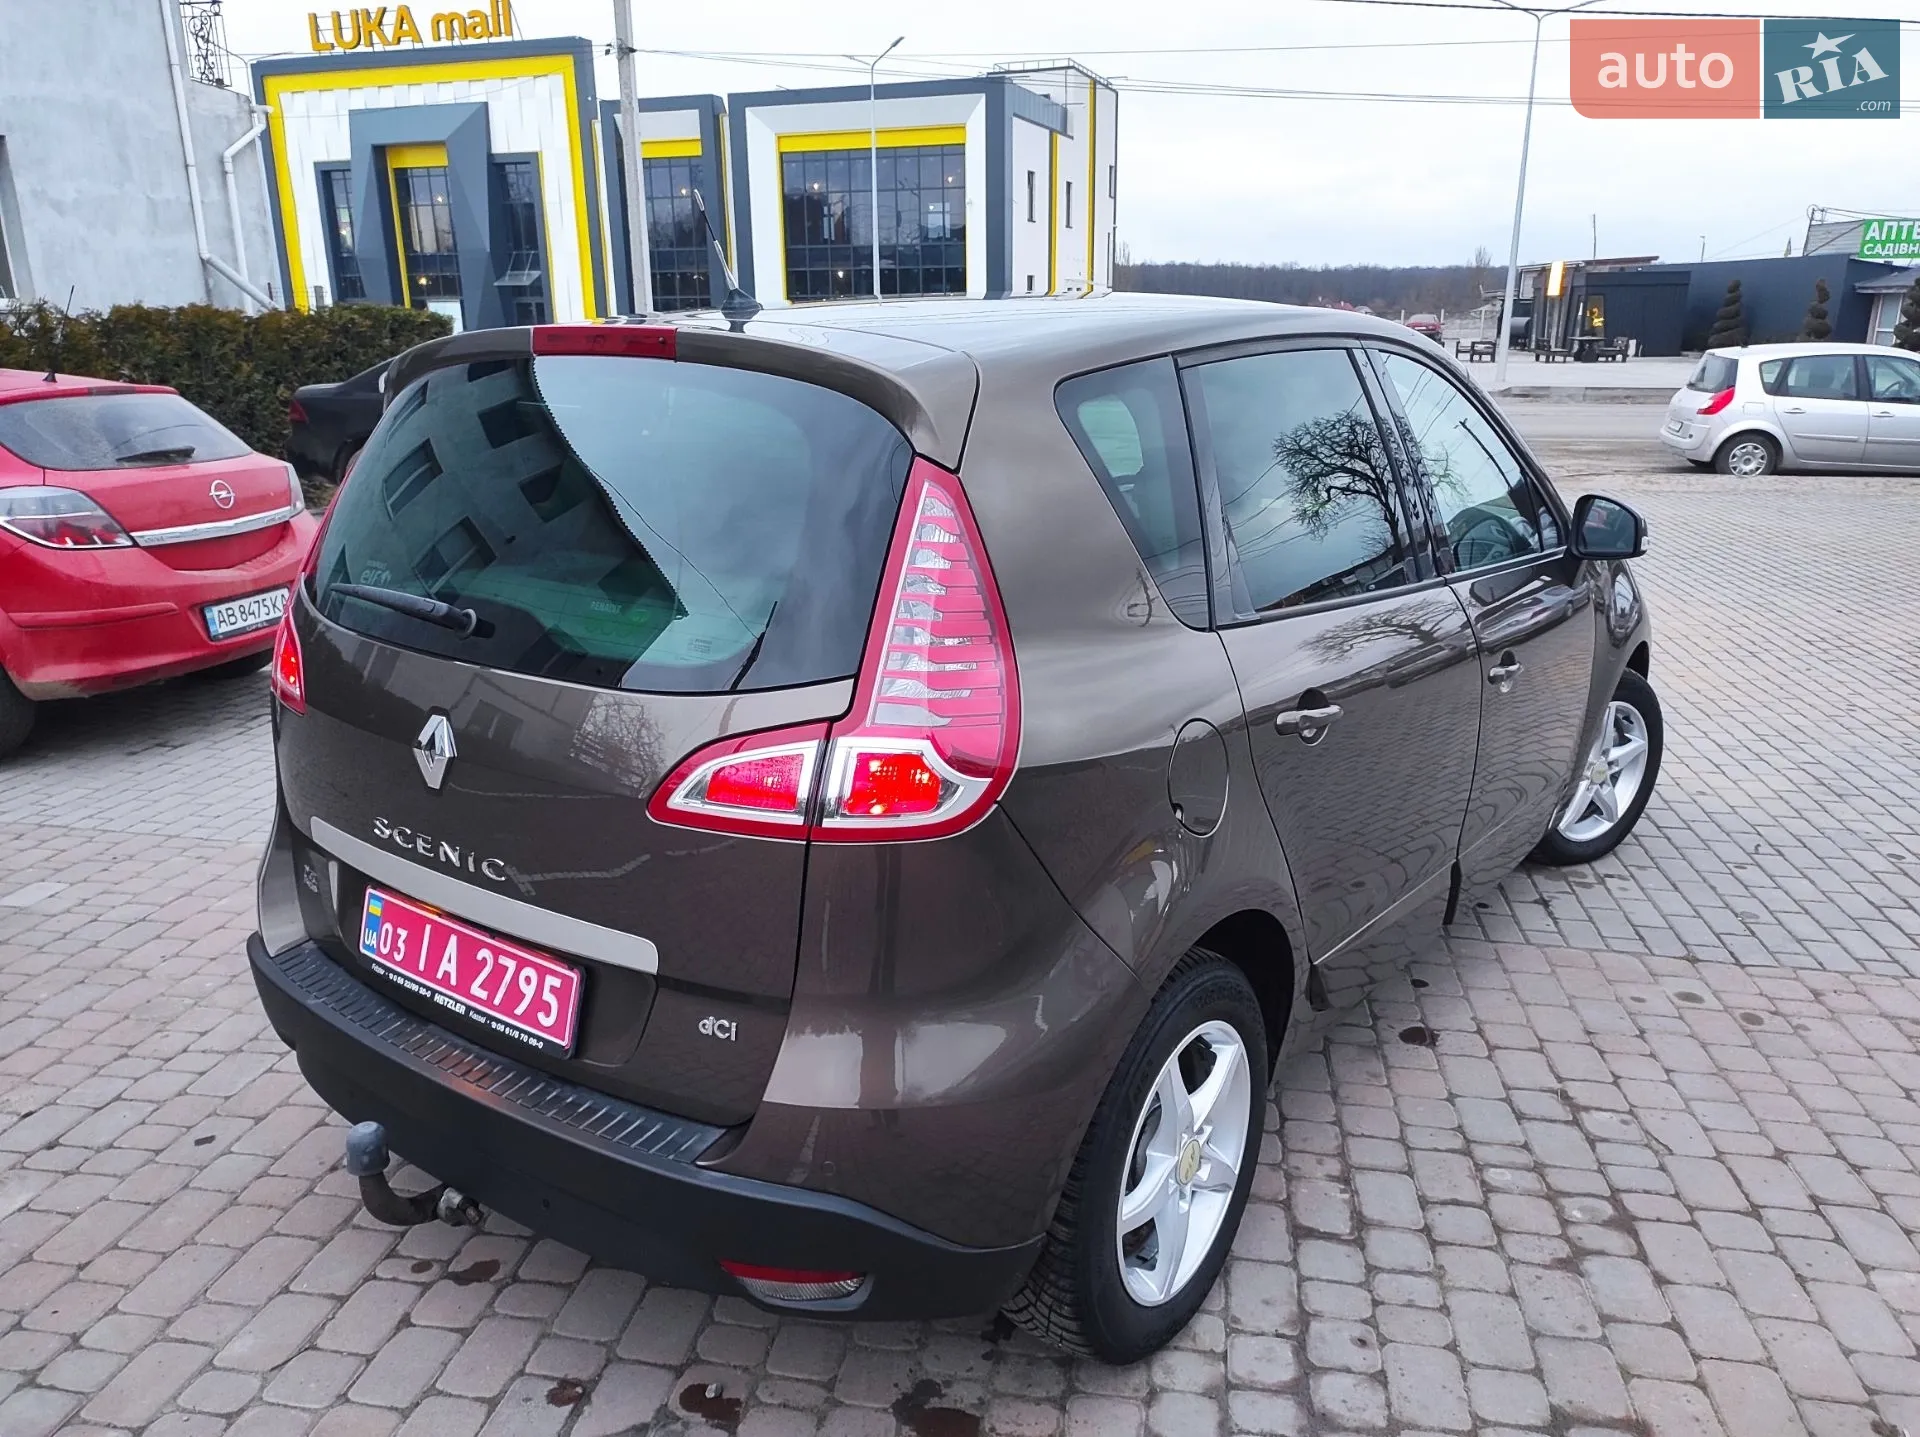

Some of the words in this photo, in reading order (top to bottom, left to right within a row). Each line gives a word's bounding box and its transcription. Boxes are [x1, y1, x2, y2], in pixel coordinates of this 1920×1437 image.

[308, 4, 423, 51] LUKA
[431, 0, 513, 42] mall
[1864, 243, 1920, 257] САДІВН
[373, 816, 506, 881] SCENIC
[364, 927, 377, 949] UA
[379, 922, 408, 962] 03
[418, 924, 458, 987] IA
[469, 947, 562, 1028] 2795
[434, 993, 466, 1015] HETZLER
